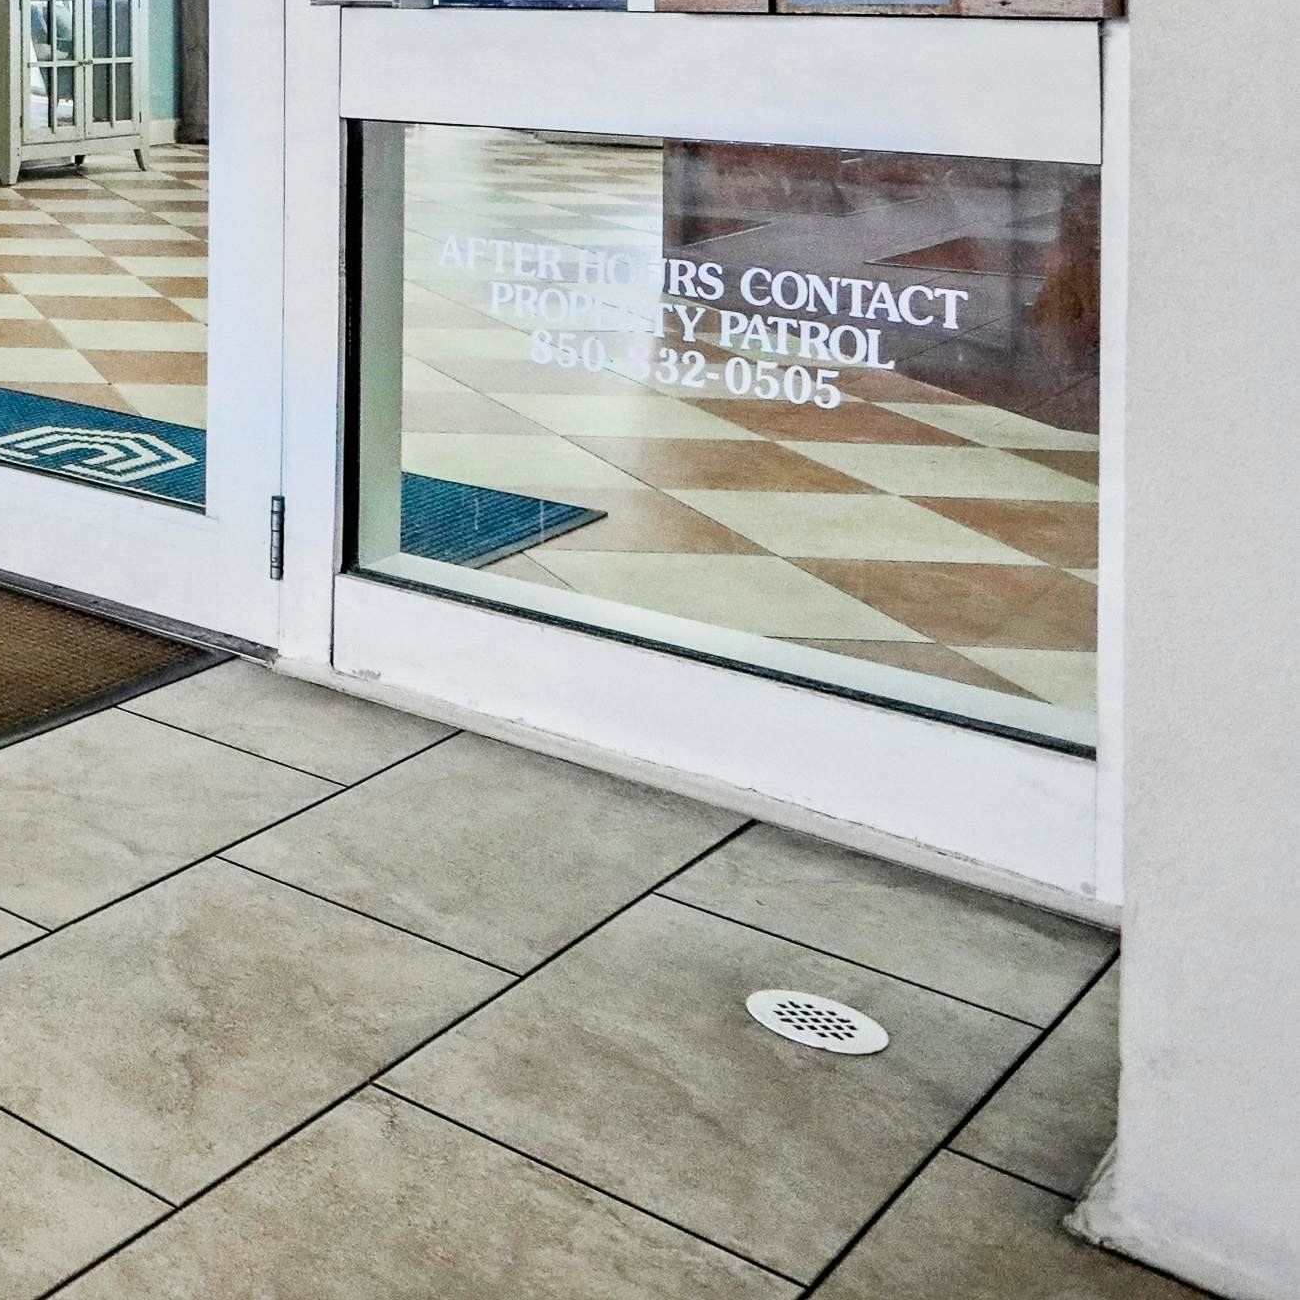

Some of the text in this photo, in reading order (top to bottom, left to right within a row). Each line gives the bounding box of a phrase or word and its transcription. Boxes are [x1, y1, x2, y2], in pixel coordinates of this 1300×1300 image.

[437, 235, 969, 330] AFTER HORS CONTACT
[490, 281, 896, 370] PROPTY PATROL
[529, 329, 841, 410] 850832-0505
